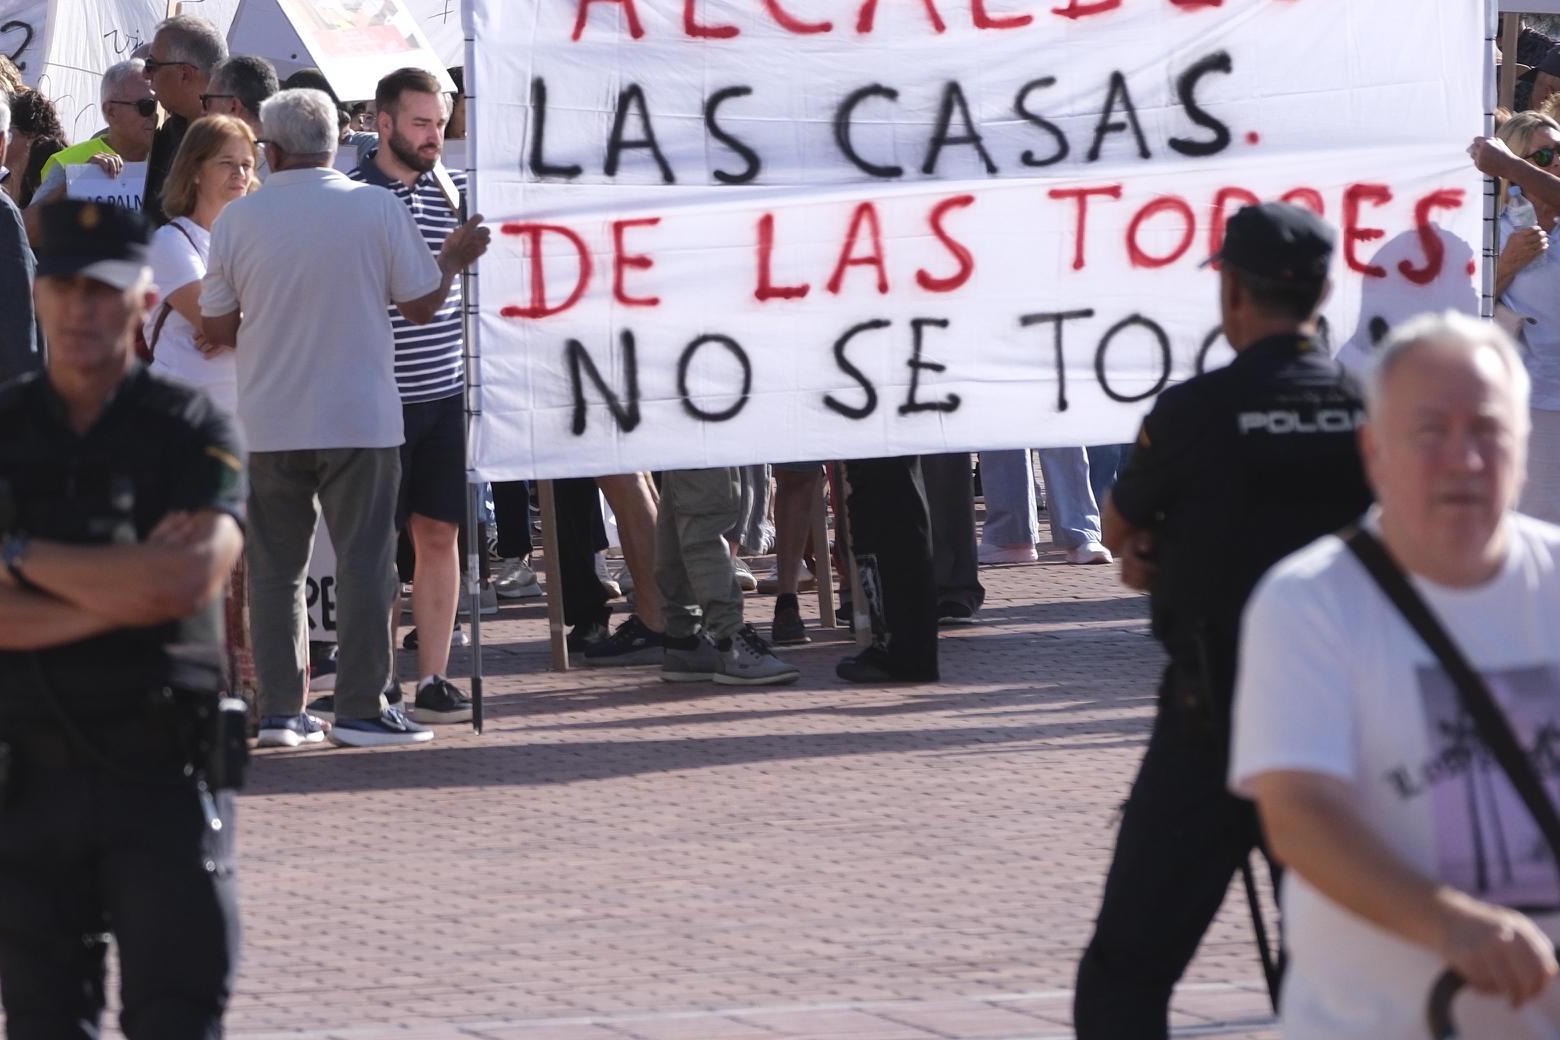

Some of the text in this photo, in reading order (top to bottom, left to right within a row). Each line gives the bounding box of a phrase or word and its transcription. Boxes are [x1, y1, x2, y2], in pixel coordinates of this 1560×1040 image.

[528, 77, 762, 186] LAS
[500, 216, 662, 319] DE
[753, 194, 975, 302] LAS
[565, 328, 754, 437] NO
[824, 318, 961, 421] SE
